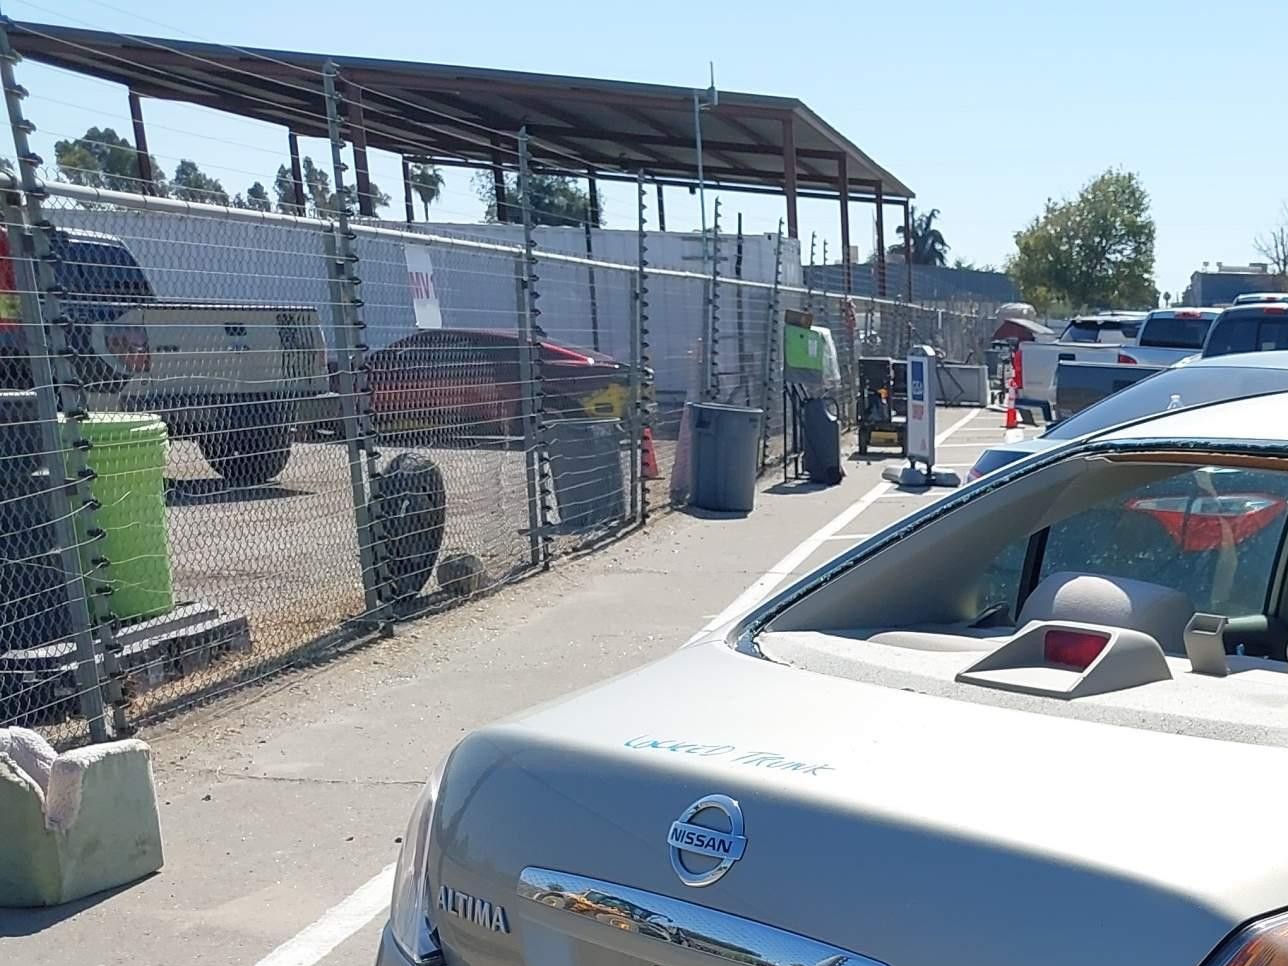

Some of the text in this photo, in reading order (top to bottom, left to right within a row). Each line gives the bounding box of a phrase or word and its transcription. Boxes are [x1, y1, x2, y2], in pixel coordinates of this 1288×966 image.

[624, 734, 836, 777] LOCKED TRUNK
[670, 827, 733, 854] NISSAN
[437, 885, 512, 934] ALTIMA
